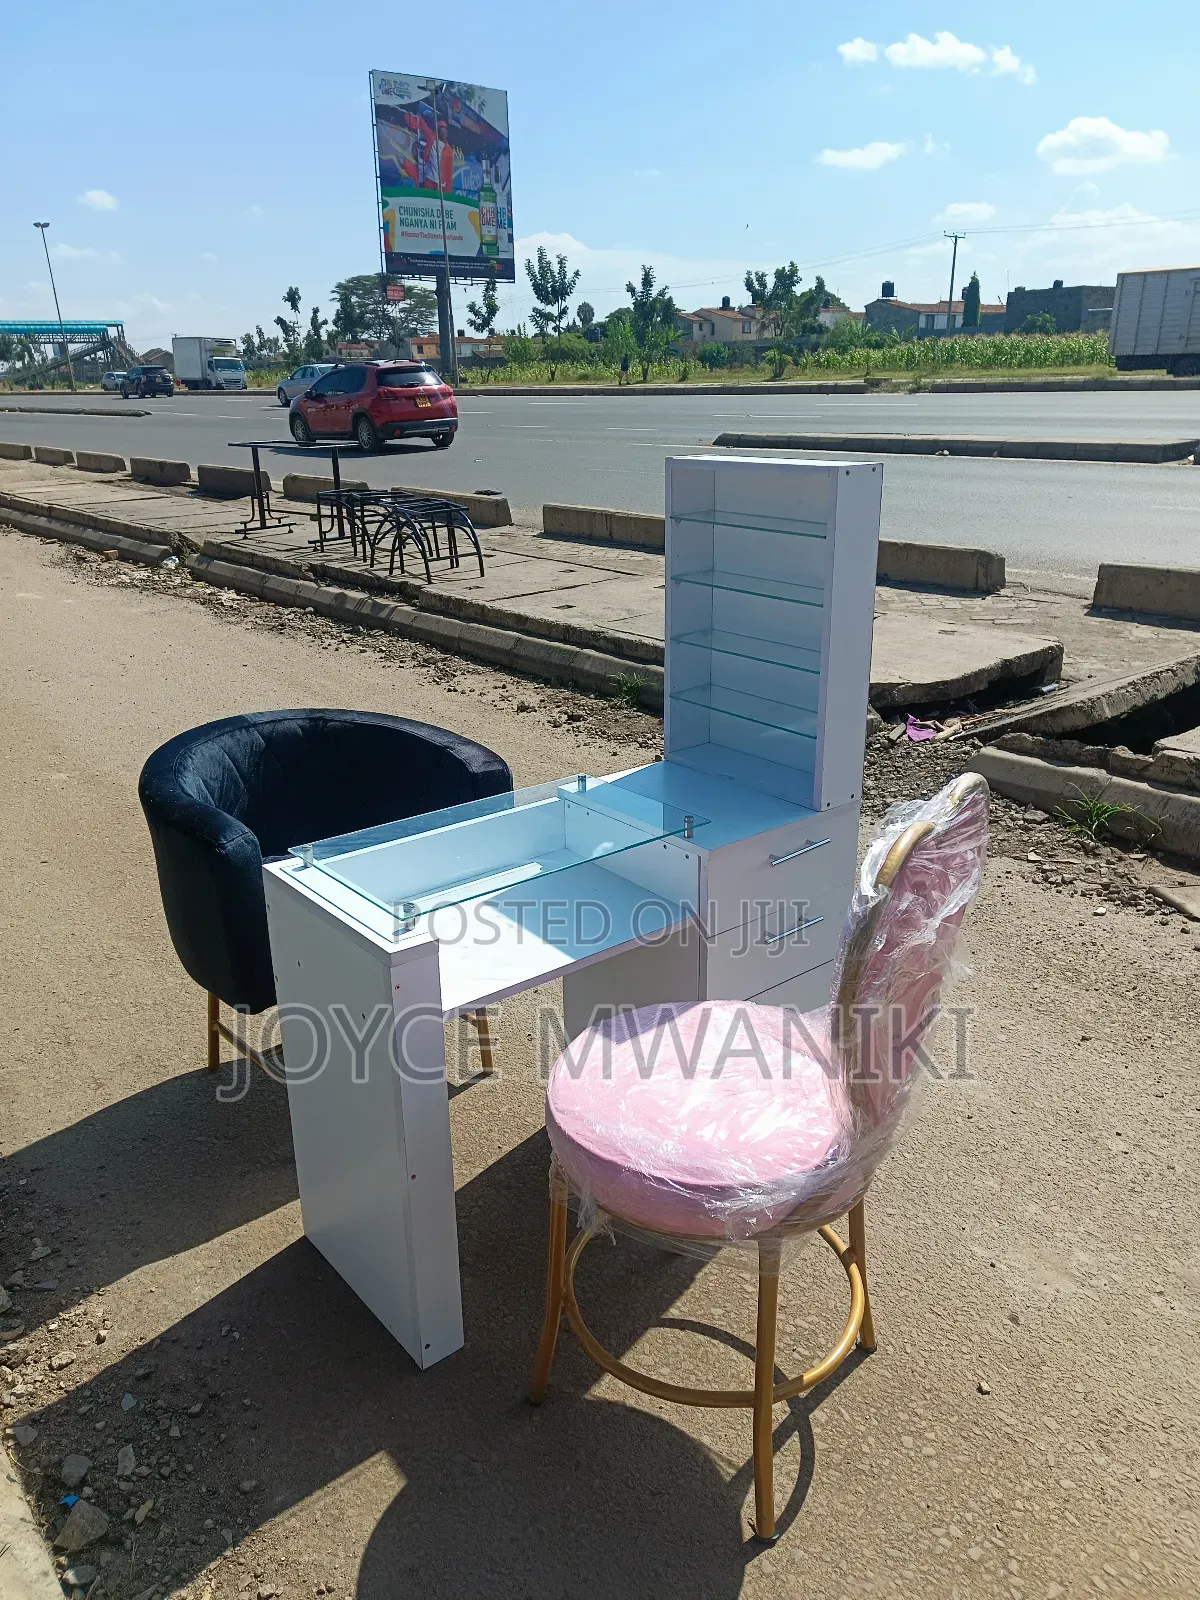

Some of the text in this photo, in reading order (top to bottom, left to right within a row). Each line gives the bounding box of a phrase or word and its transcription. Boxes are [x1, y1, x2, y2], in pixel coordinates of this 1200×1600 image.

[398, 205, 454, 220] CHUNISHA DBE
[481, 205, 496, 217] CHR
[399, 216, 457, 231] NGANYA NI FAM
[481, 215, 496, 227] OME
